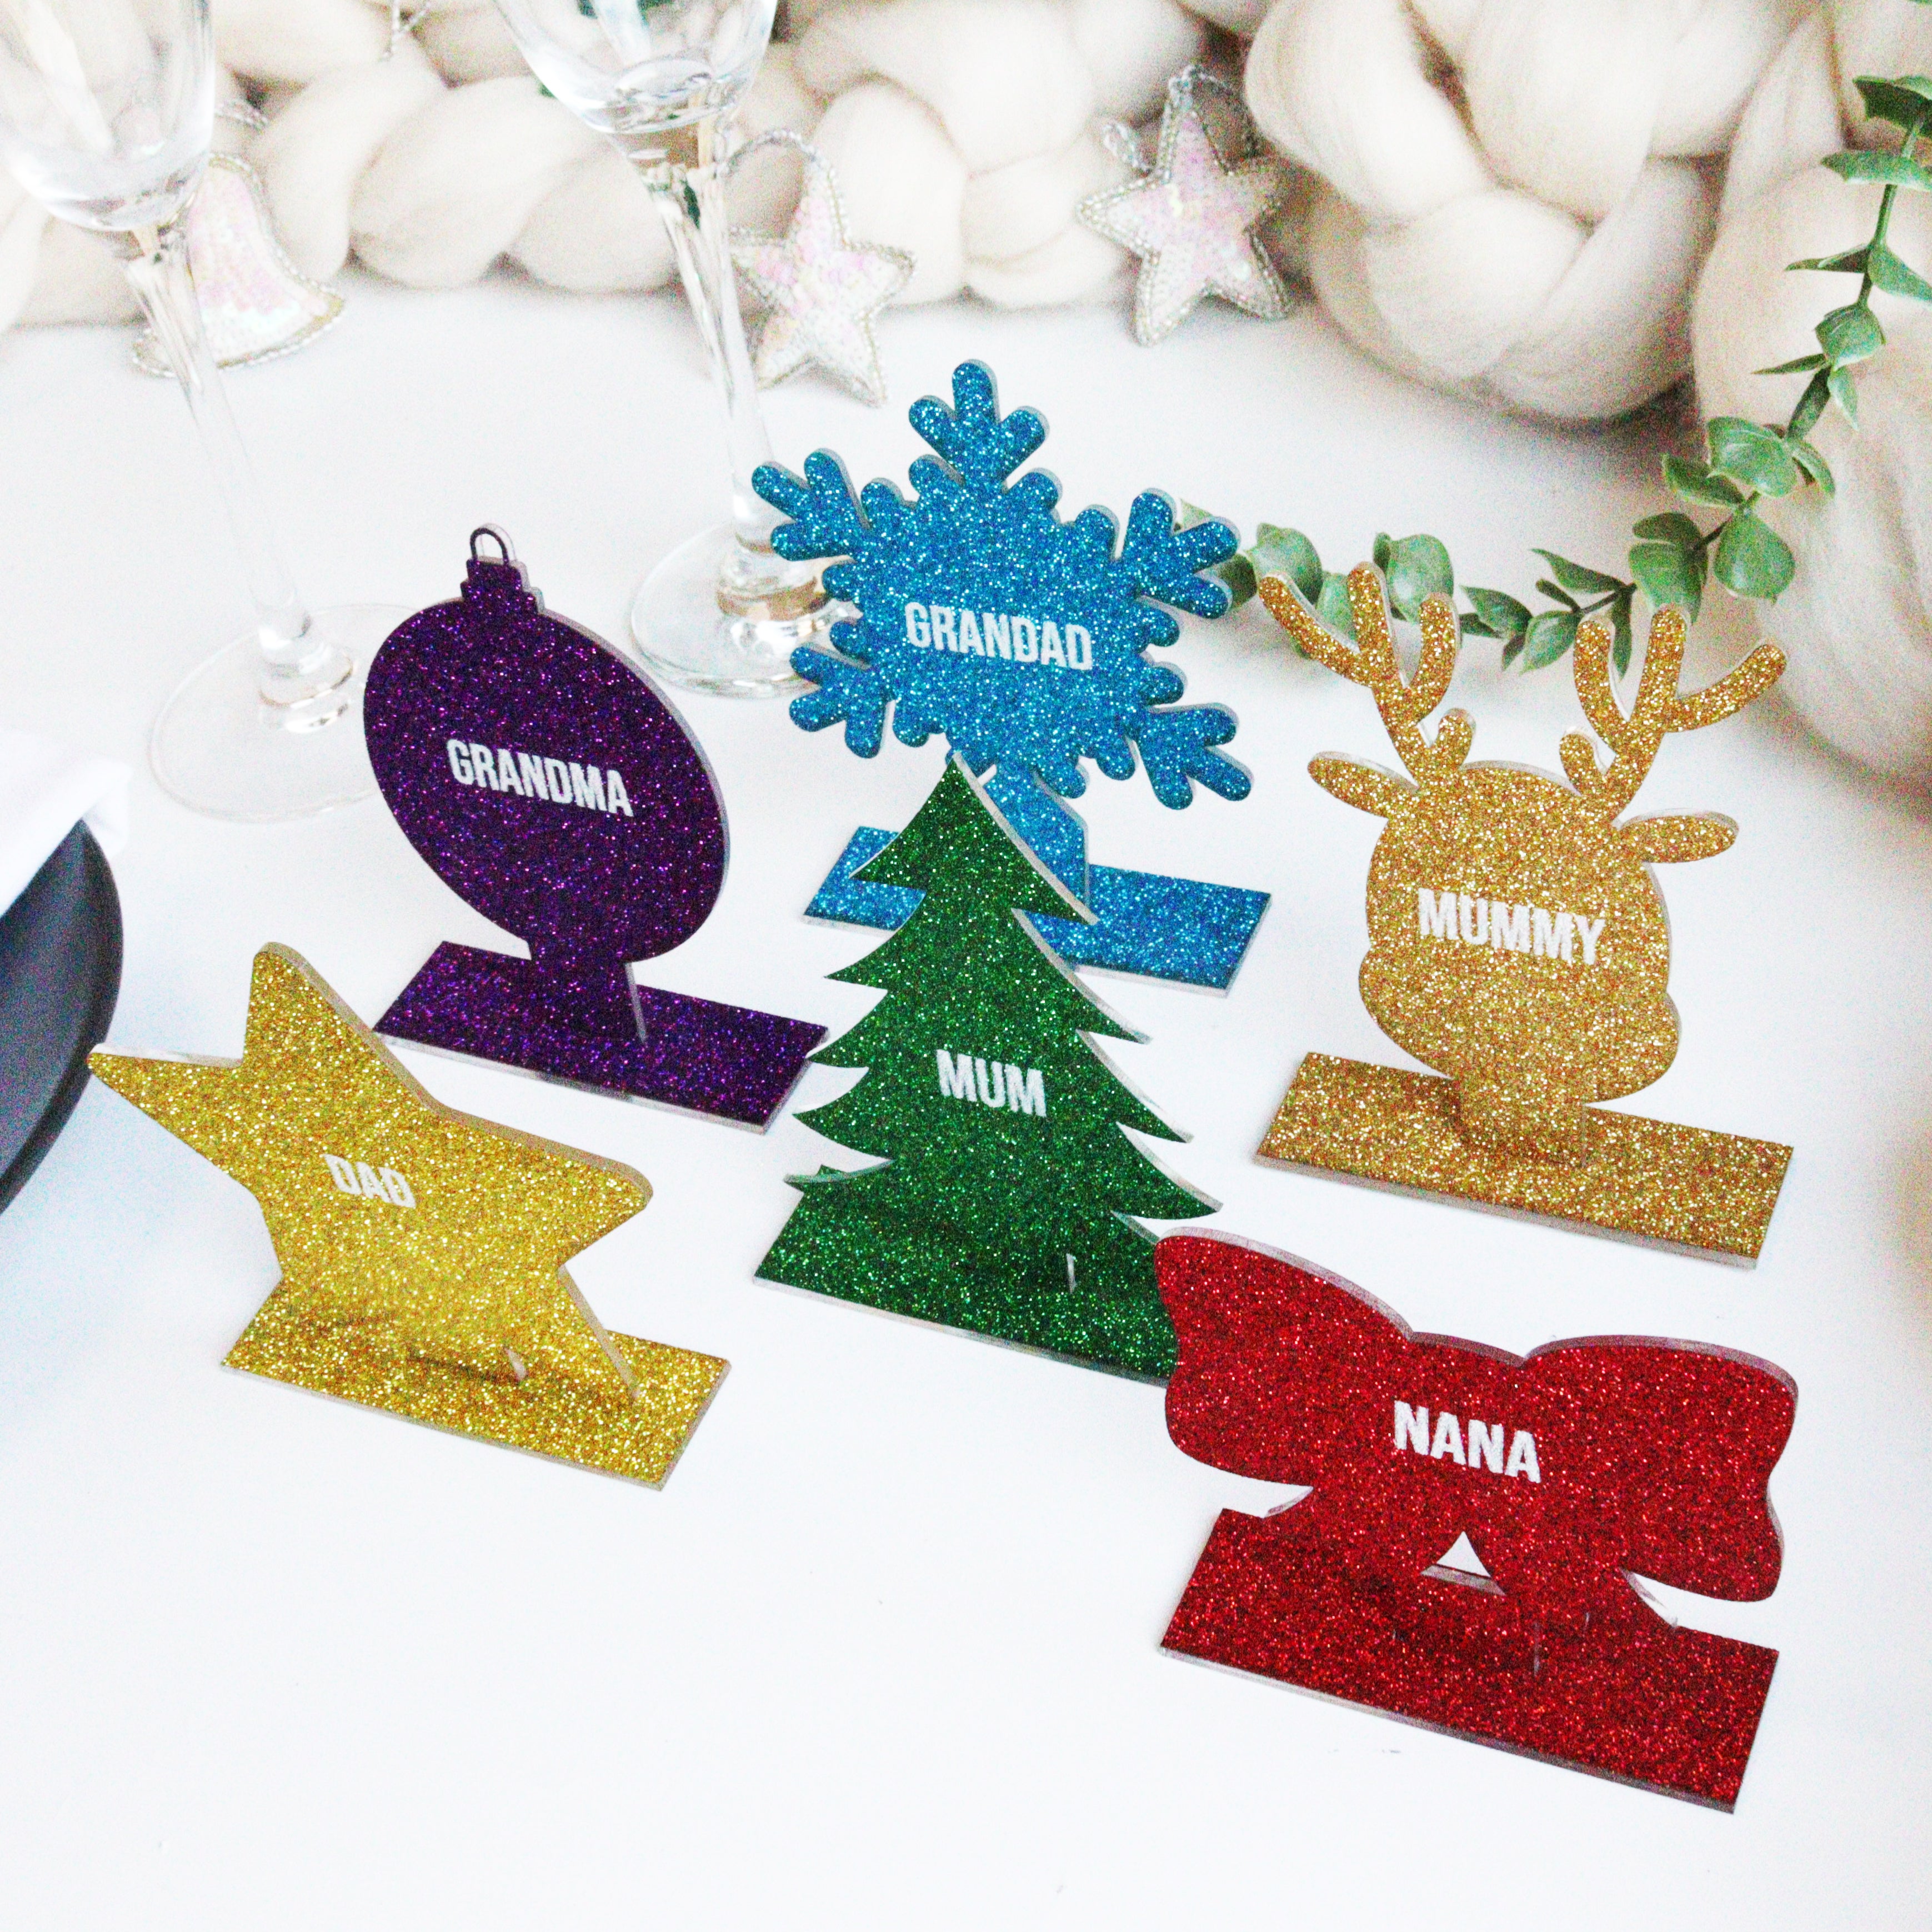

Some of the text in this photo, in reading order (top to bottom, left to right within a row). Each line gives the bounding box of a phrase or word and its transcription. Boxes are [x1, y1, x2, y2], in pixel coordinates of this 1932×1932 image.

[905, 602, 1093, 671] GRANDAD
[447, 739, 634, 817] GRANDMA
[1417, 889, 1605, 965] MUMMY
[937, 1049, 1046, 1117] MUM
[323, 1154, 416, 1208] DAD
[1394, 1401, 1541, 1484] NANA
